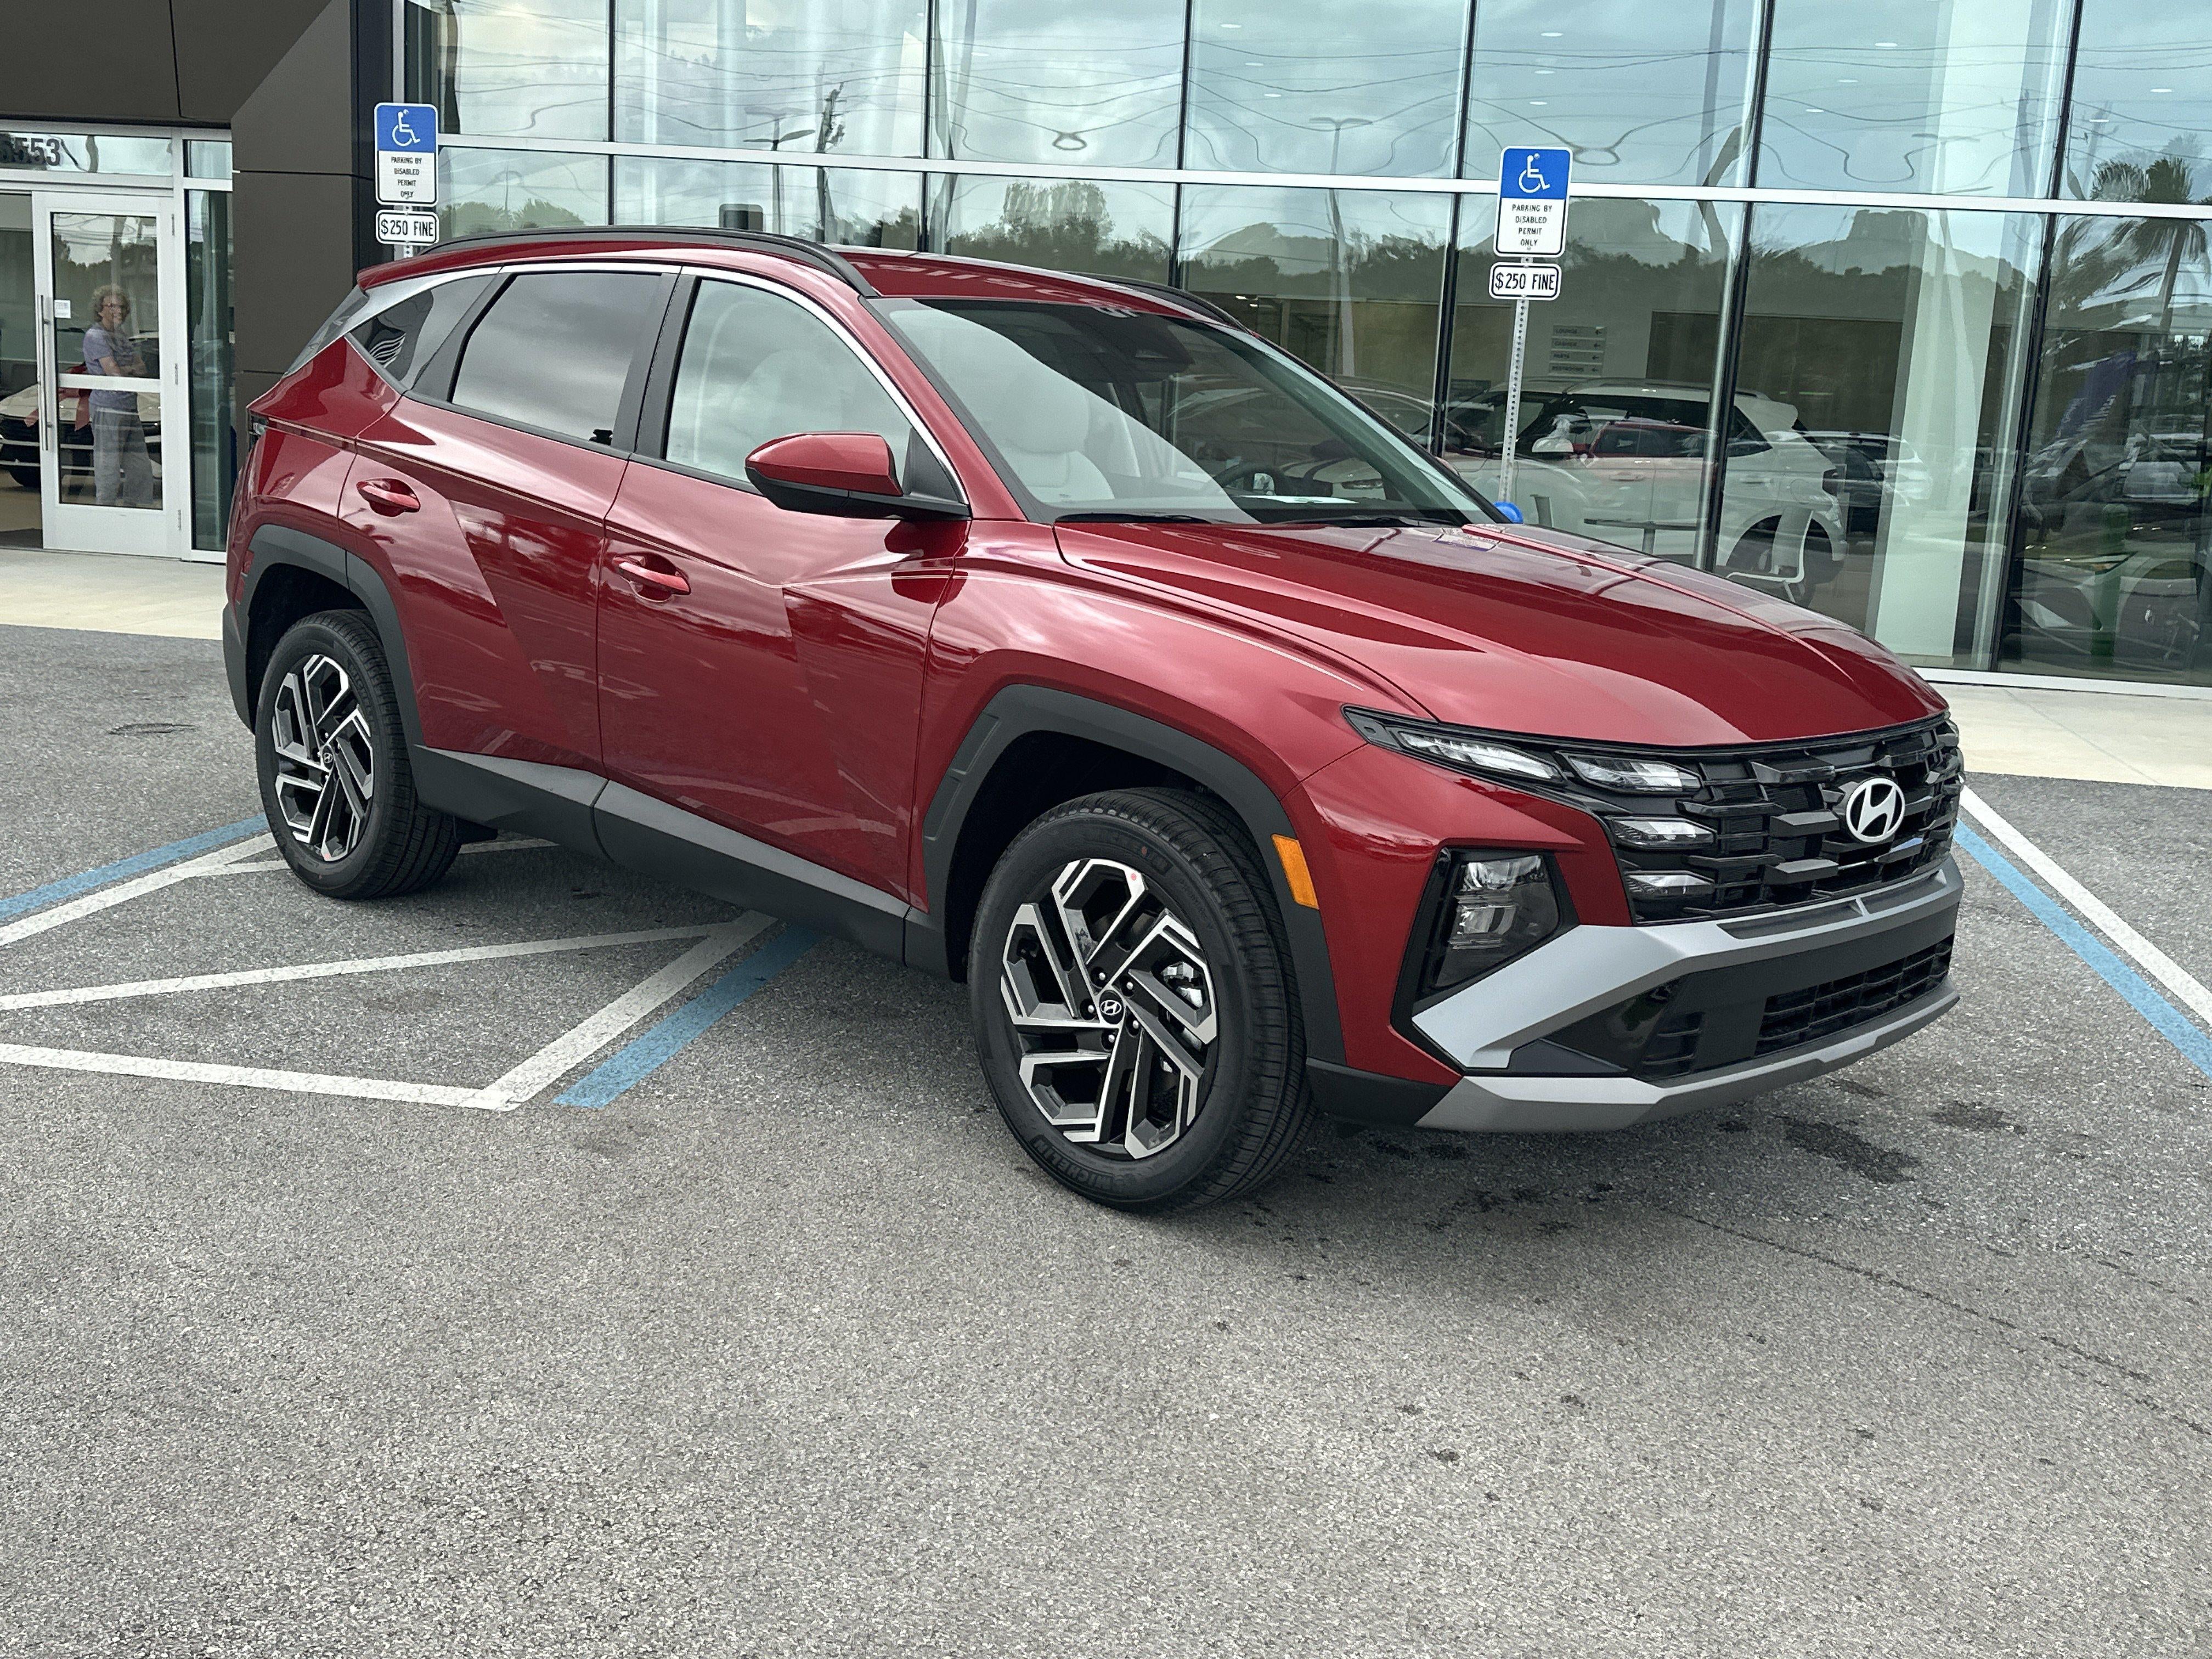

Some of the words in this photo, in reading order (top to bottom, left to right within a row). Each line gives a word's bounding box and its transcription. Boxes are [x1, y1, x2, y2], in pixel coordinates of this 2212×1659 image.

[381, 218, 408, 236] $250
[414, 221, 434, 236] FINE
[1494, 272, 1526, 290] $250
[1532, 274, 1556, 290] FINE
[1032, 1139, 1111, 1190] MICHELIN
